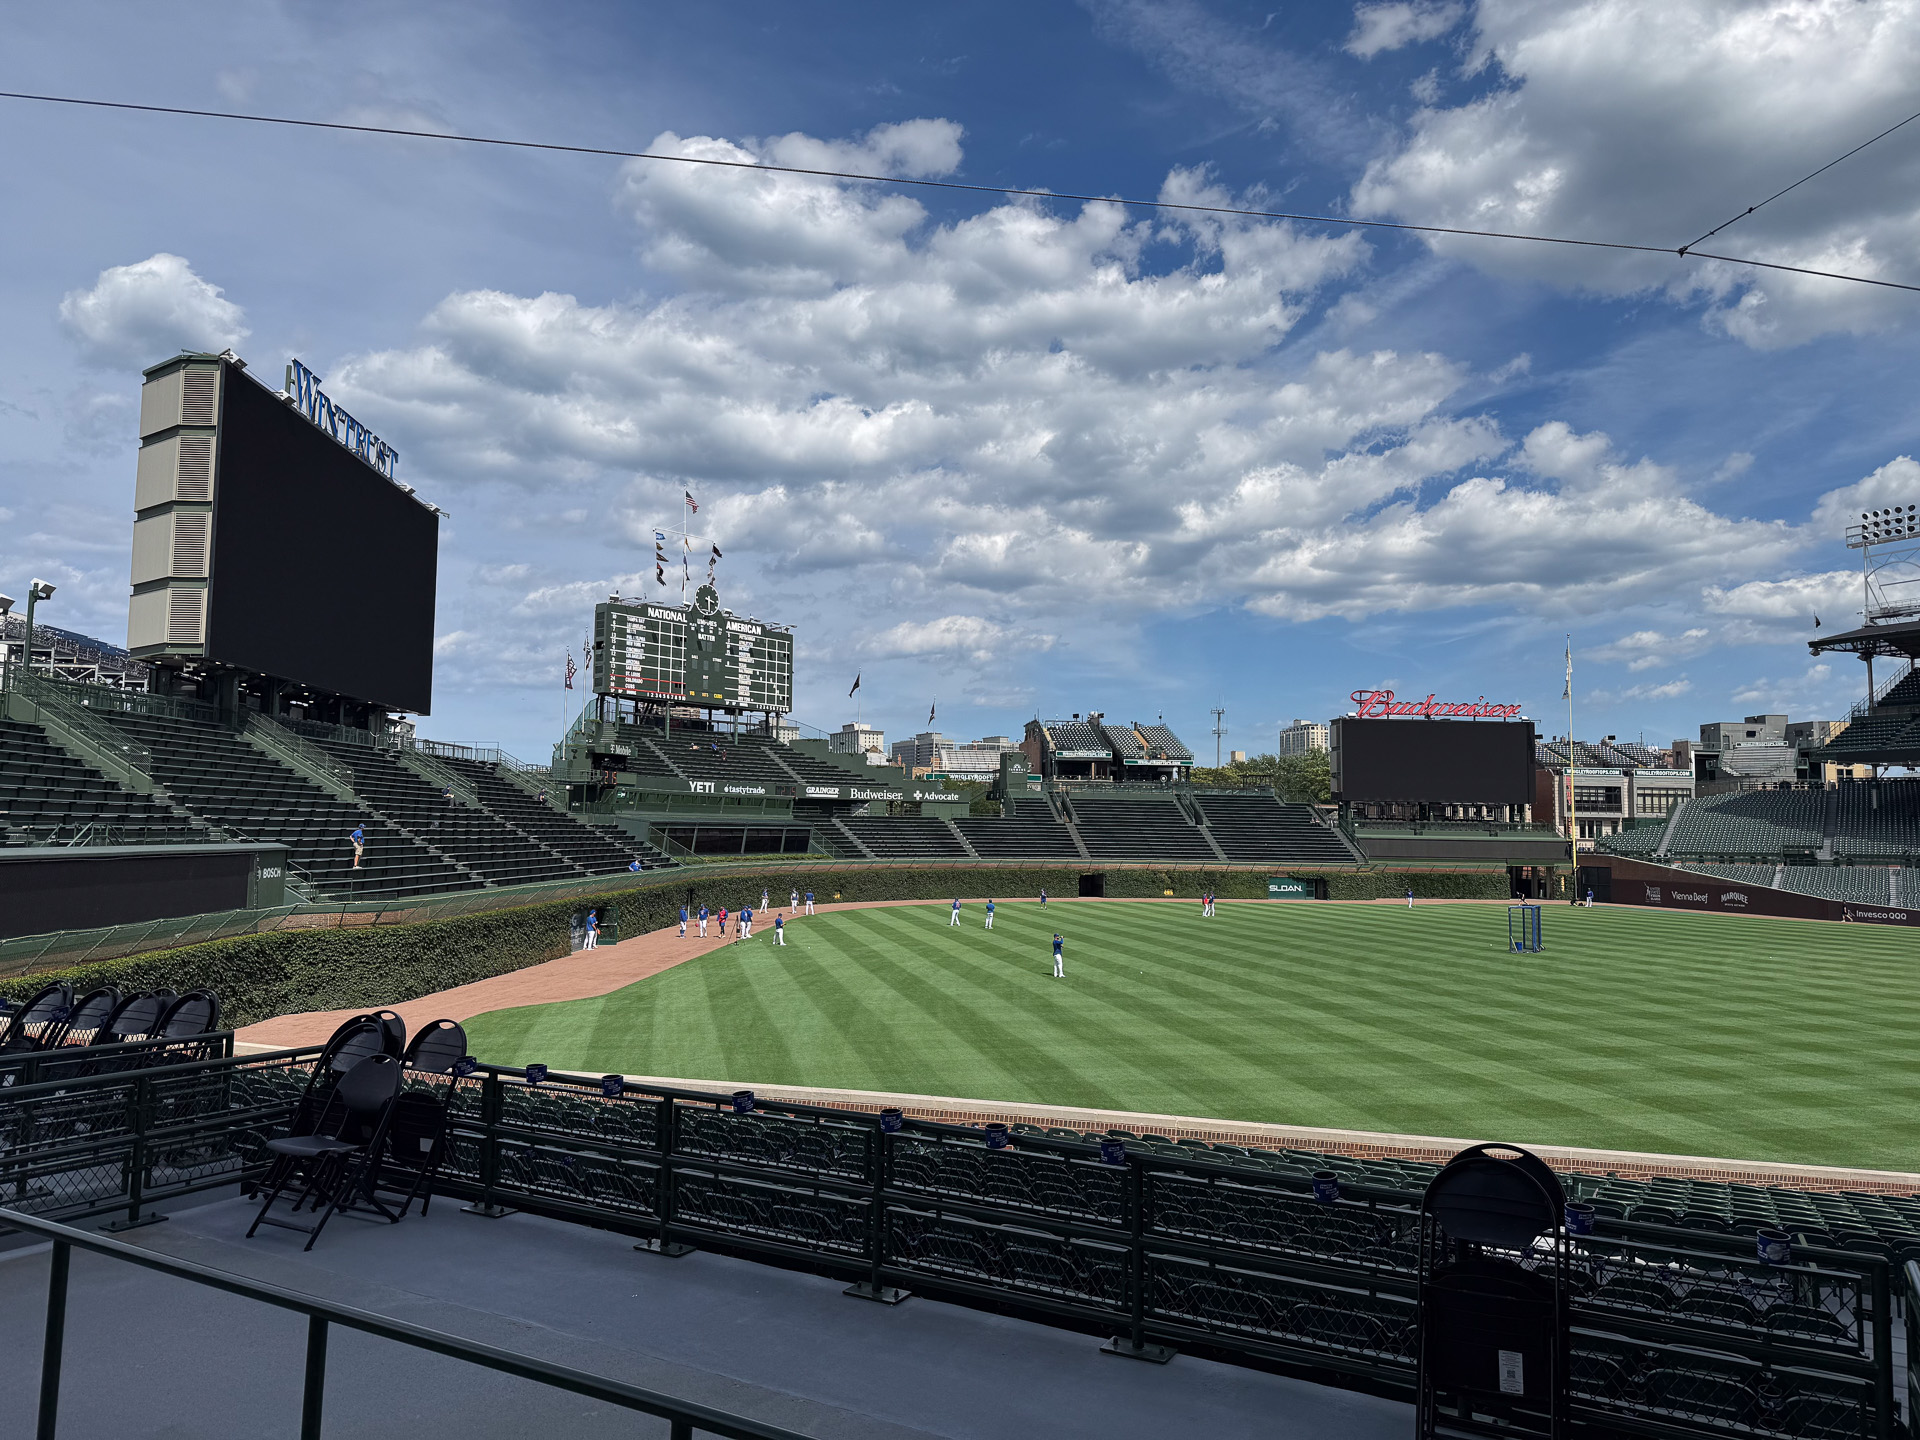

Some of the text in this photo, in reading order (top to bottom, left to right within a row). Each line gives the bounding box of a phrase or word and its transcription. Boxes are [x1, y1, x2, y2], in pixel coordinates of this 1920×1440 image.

[291, 358, 399, 479] WINTRUST
[647, 607, 688, 624] NATIONAL
[725, 620, 762, 636] AMERICAN
[698, 633, 715, 642] BATTER
[1350, 689, 1522, 718] Budweiser
[688, 781, 715, 793] YETI
[729, 785, 766, 795] tastytrade
[805, 786, 840, 794] GRAINGER
[924, 791, 959, 800] Advocate
[262, 867, 282, 878] BOSCH
[1671, 890, 1693, 901] Vienna
[1693, 892, 1708, 904] Beef
[1721, 891, 1749, 904] MARQUEE
[1856, 910, 1907, 920] Invesco QQQ
